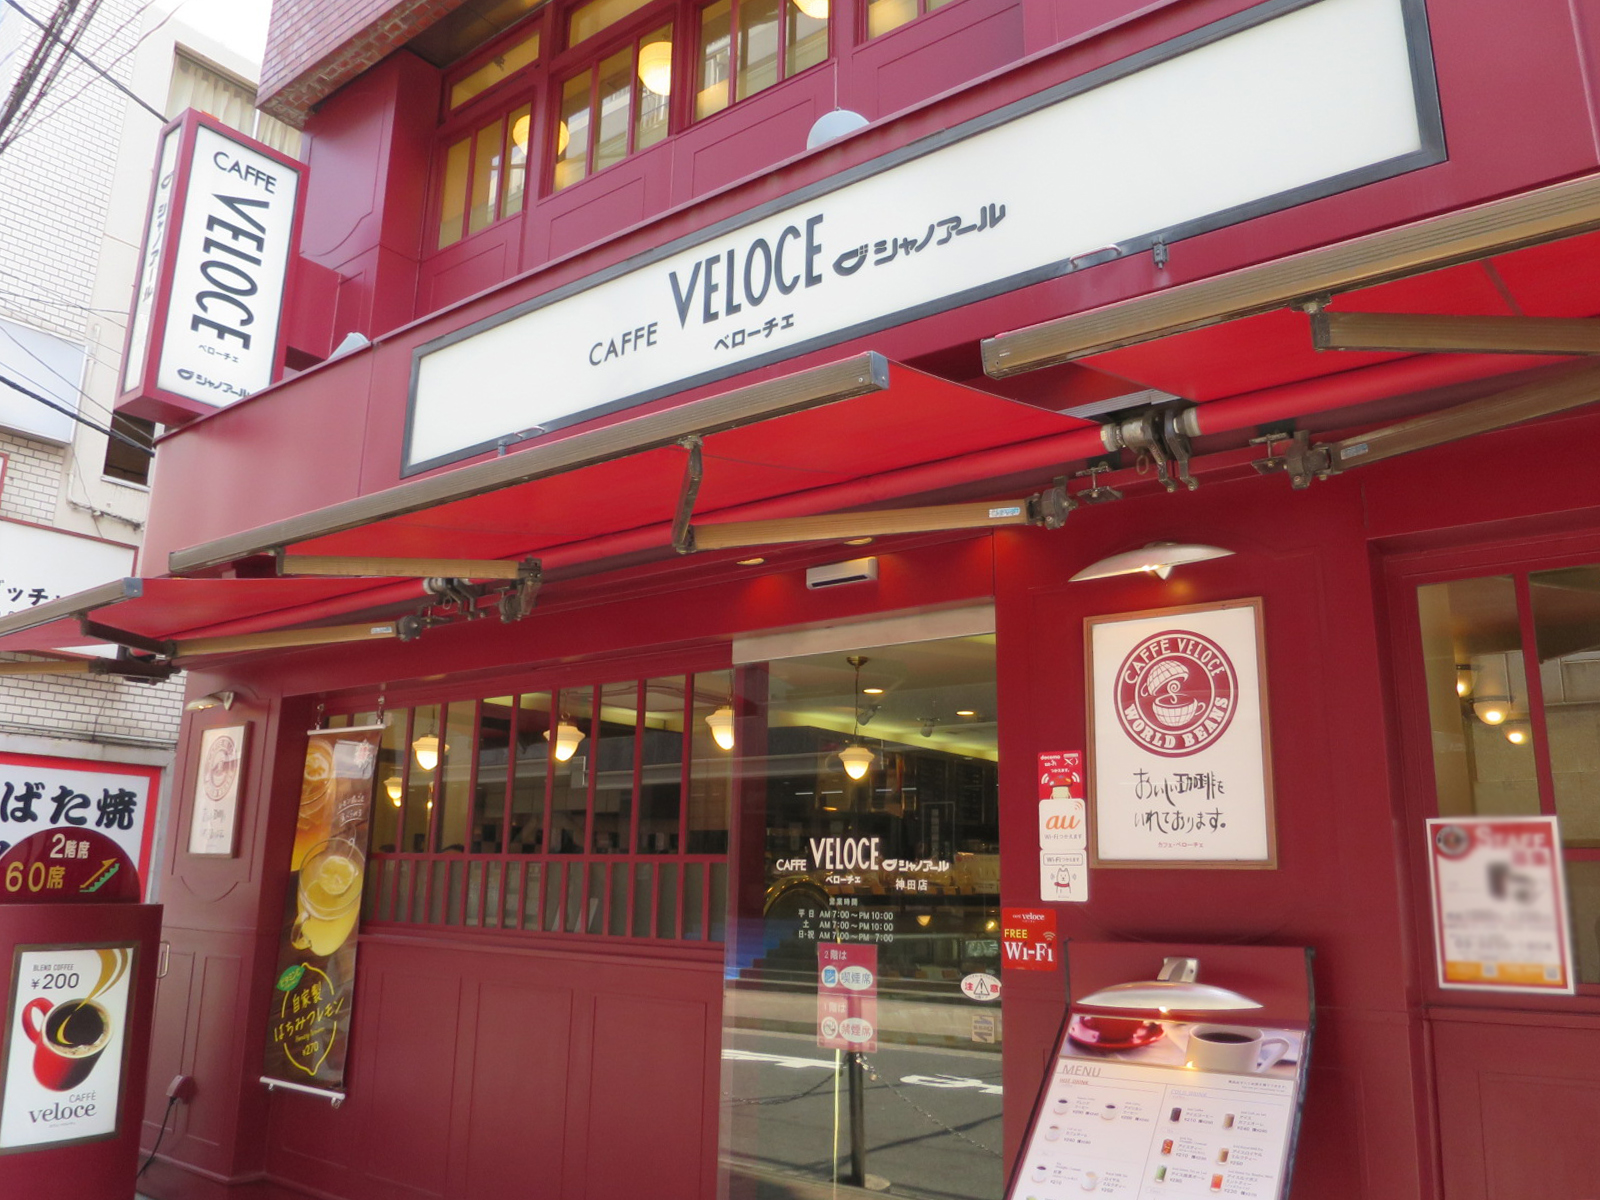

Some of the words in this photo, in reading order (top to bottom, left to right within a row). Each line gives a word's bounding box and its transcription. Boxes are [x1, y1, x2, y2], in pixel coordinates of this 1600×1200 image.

[213, 151, 277, 194] CAFFE
[873, 203, 1006, 266] シャノアール
[190, 193, 270, 351] VELOCE
[589, 322, 658, 367] CAFFE
[668, 213, 824, 330] VELOCE
[713, 313, 795, 352] ベローチェ
[198, 344, 239, 363] ベローチェ
[1177, 638, 1225, 678] VELOCE
[1123, 702, 1176, 750] WORLD
[1183, 696, 1229, 748] BEANS
[1045, 814, 1081, 831] au
[50, 833, 91, 860] 2階席
[776, 859, 807, 872] CAFFE
[810, 837, 880, 871] VELOCE
[898, 859, 949, 873] シャノアール
[5, 861, 66, 893] 60席
[825, 875, 861, 885] ベローチェ
[895, 878, 928, 891] 神田店
[829, 897, 858, 907] 営業時間
[1021, 911, 1046, 921] veloce
[1003, 928, 1028, 939] FREE
[1003, 941, 1054, 962] Wi-Fi
[53, 963, 74, 972] COFFEE
[31, 972, 80, 990] ¥200
[840, 972, 871, 985] 喫煙席
[292, 980, 323, 1014] 自家製
[273, 996, 345, 1043] はちみつレモン
[1062, 1064, 1102, 1078] MENU
[28, 1101, 98, 1123] veloce
